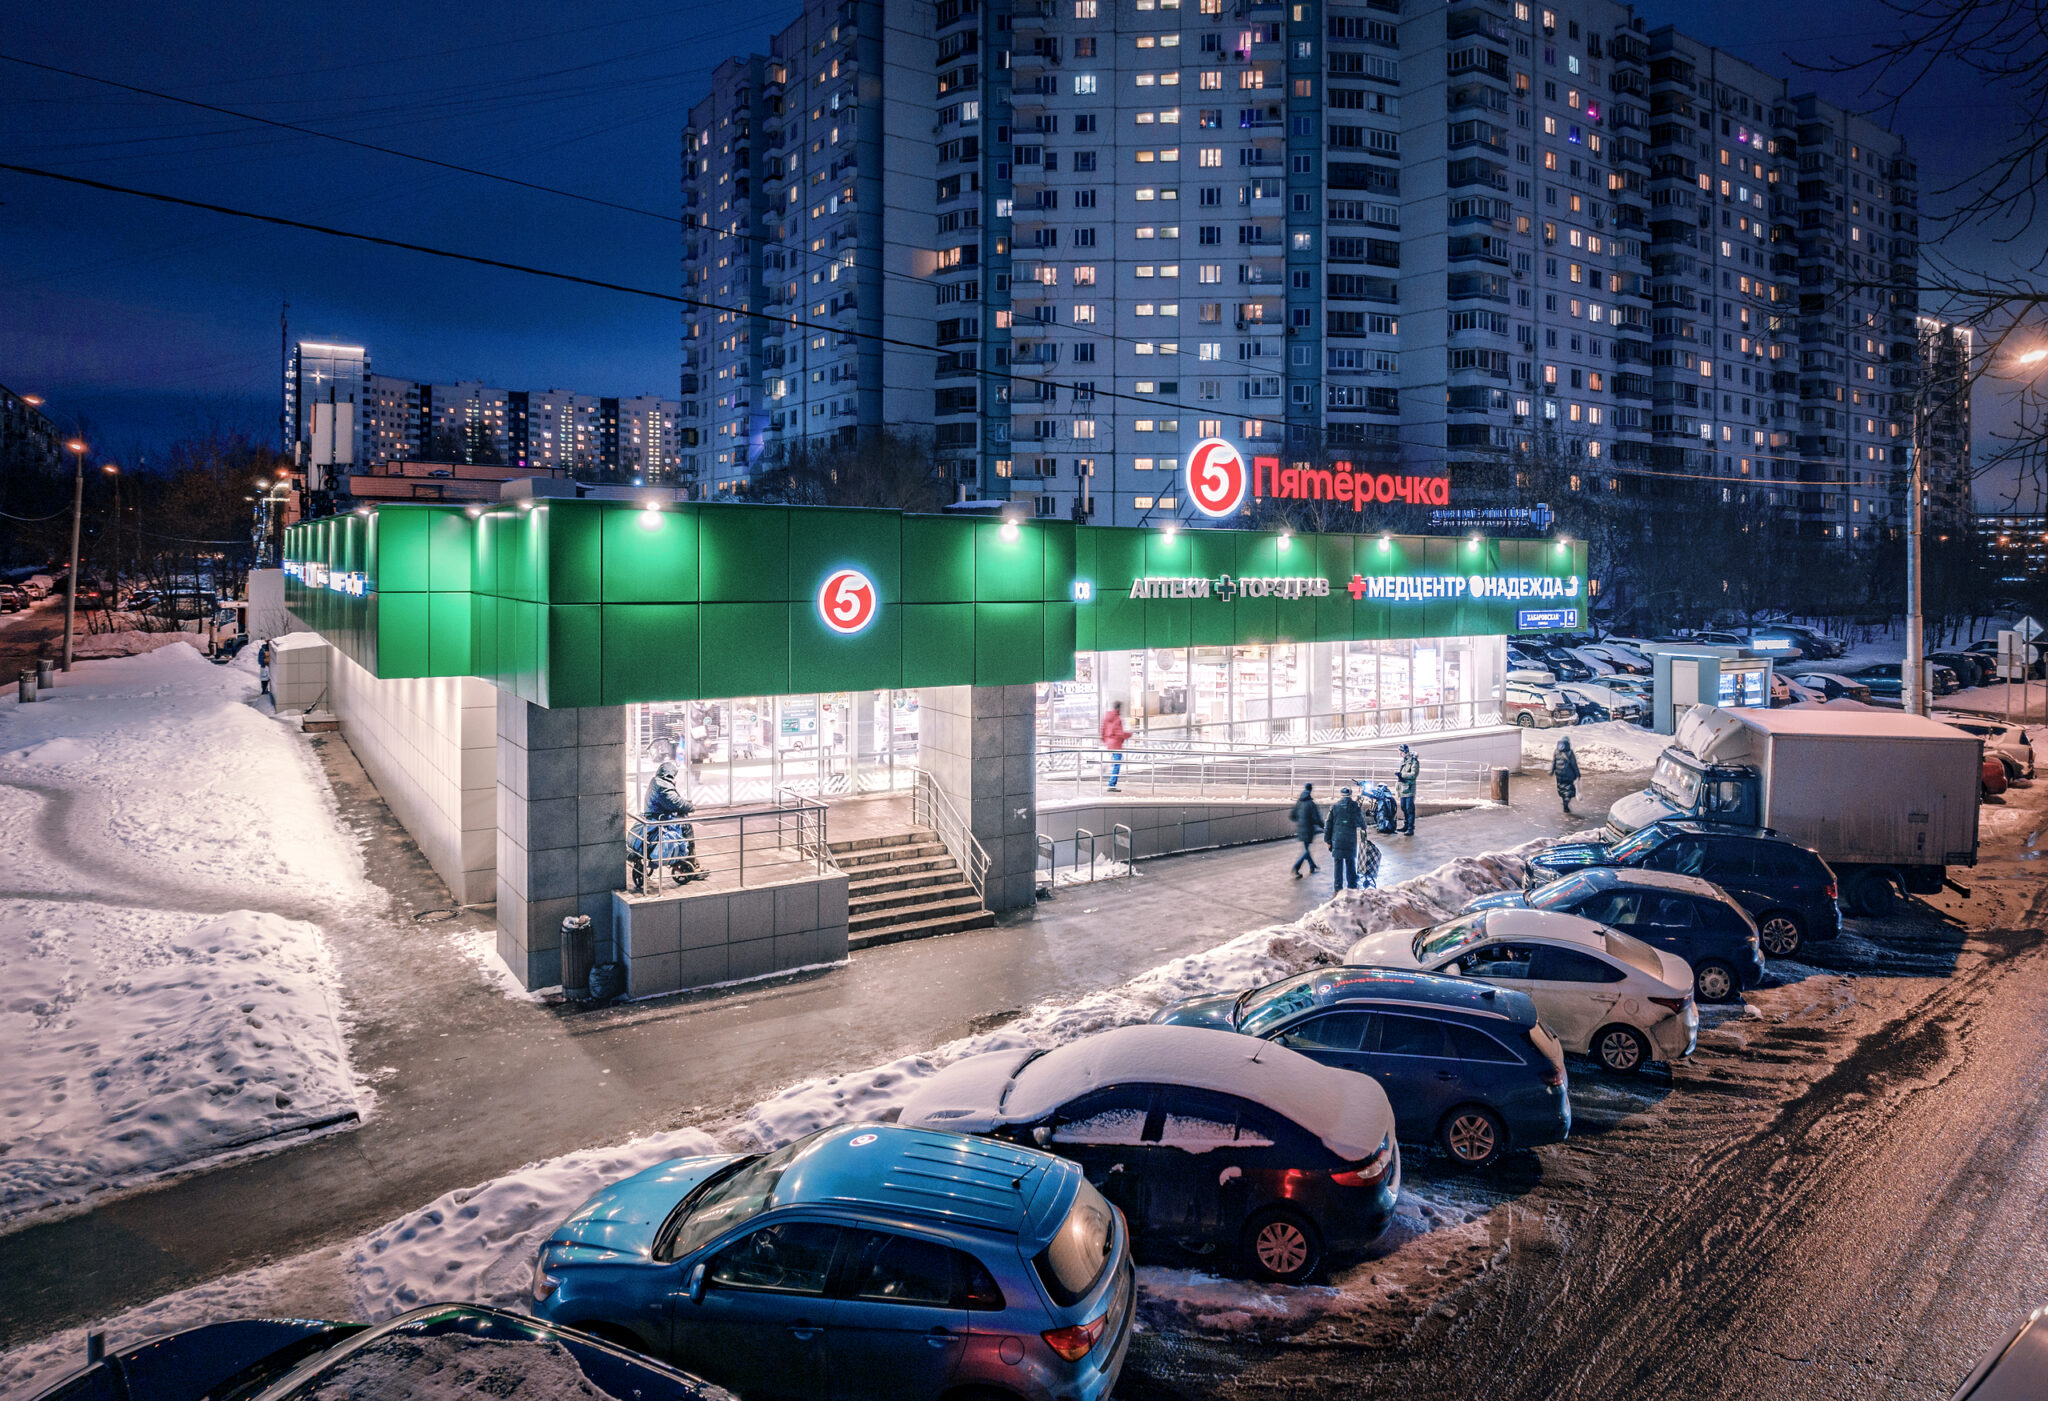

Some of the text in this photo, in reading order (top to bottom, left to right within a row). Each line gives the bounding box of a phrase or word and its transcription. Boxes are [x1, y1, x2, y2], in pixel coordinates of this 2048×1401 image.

[1200, 446, 1449, 512] 5 Пятёрочка
[833, 575, 867, 621] 5
[1129, 577, 1330, 600] АПТЕКИ ГОРЗДРАВ
[1367, 576, 1564, 600] МЕДЦЕНТР НАДЕЖДА
[1568, 611, 1574, 622] 4
